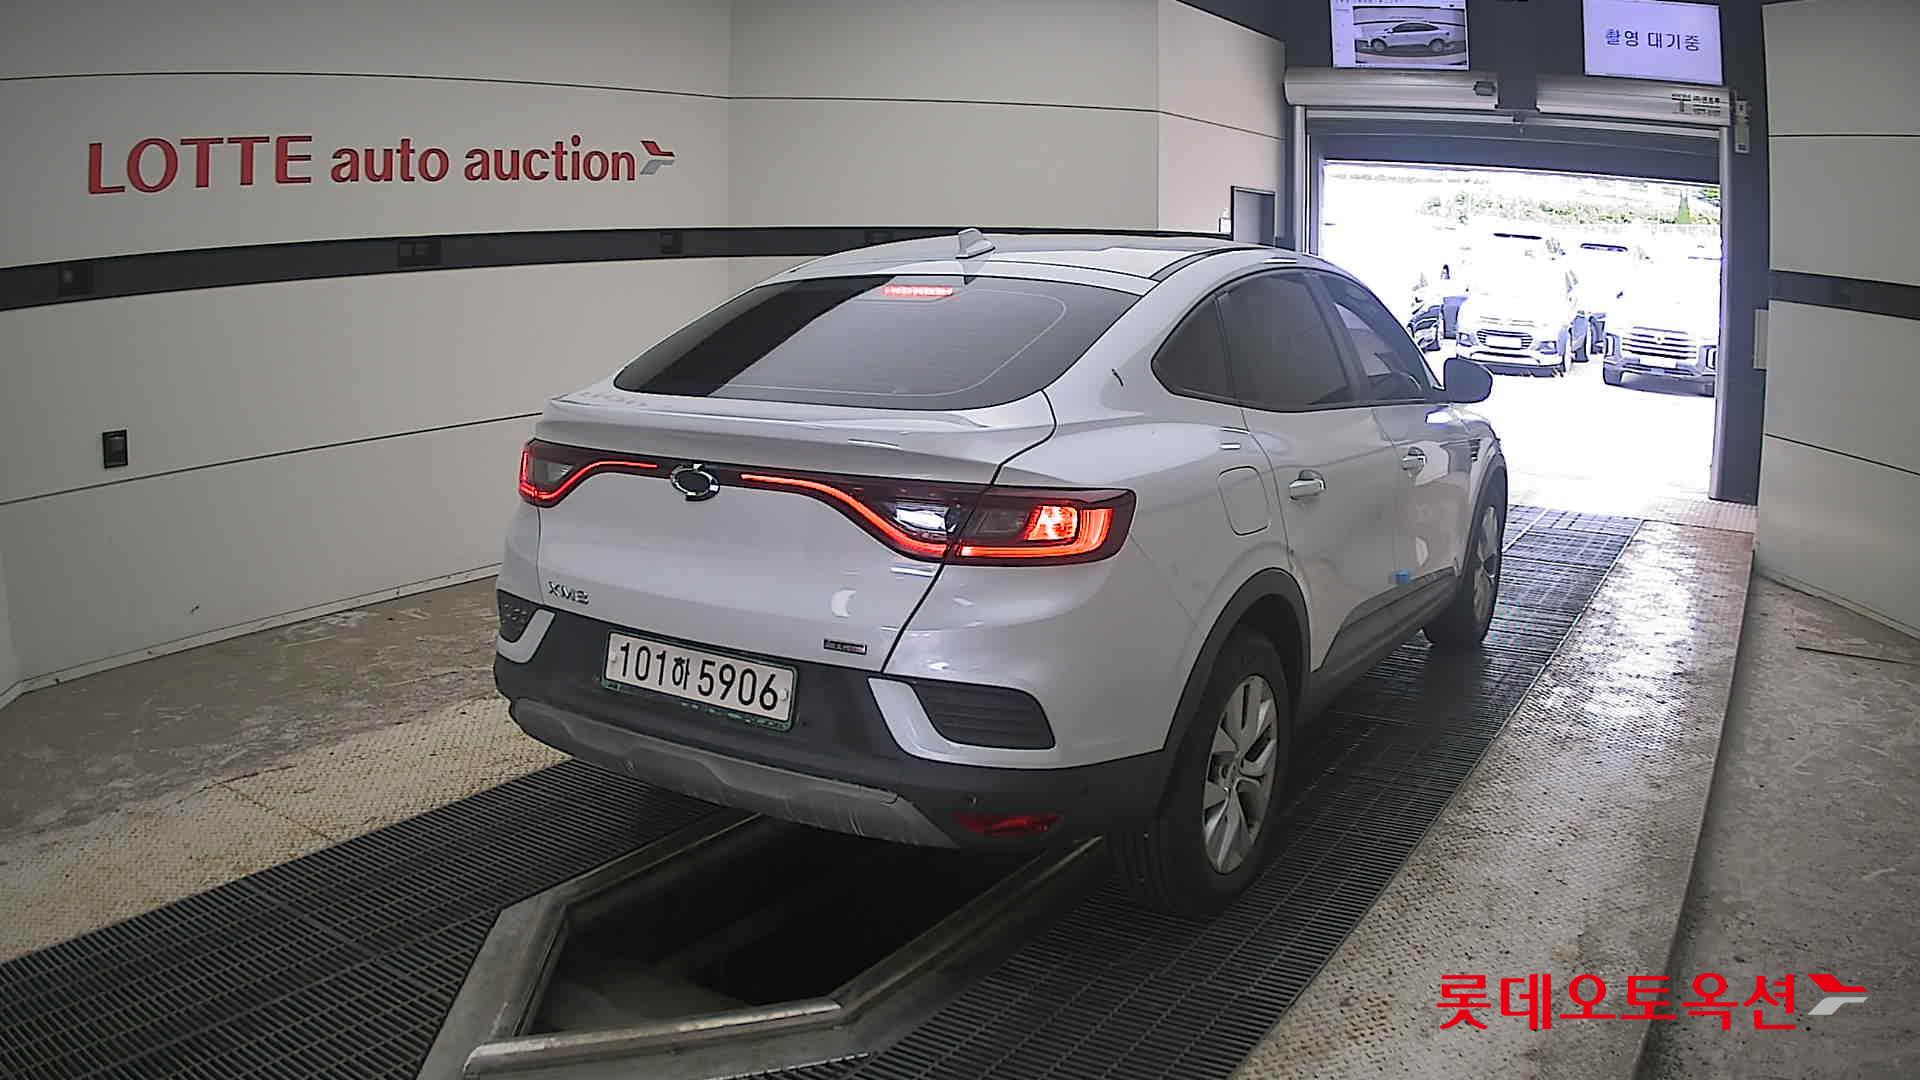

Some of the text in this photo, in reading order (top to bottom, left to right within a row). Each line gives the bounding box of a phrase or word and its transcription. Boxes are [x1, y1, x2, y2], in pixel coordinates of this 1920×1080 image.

[1647, 31, 1701, 52] 대기중
[88, 134, 637, 194] LOTTE auto auction
